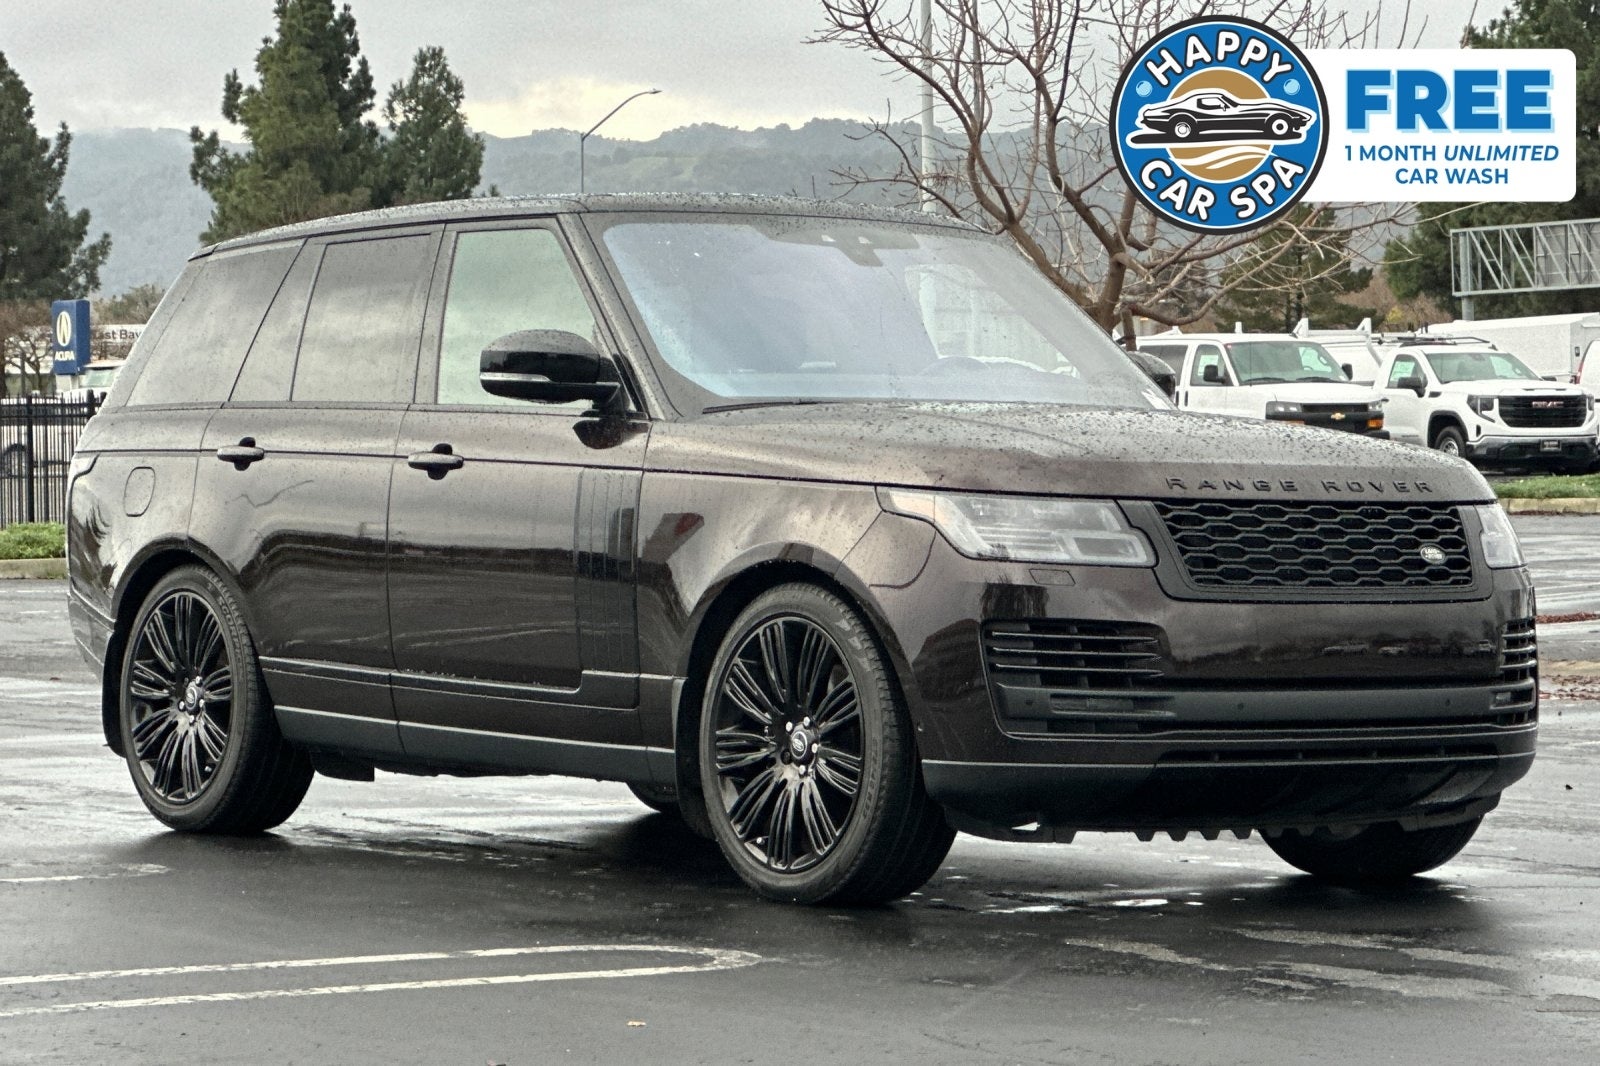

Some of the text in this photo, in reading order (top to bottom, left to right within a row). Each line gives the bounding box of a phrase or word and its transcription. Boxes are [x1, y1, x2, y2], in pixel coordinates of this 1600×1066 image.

[55, 351, 75, 361] ACURA
[1166, 477, 1433, 493] RANGE ROVER
